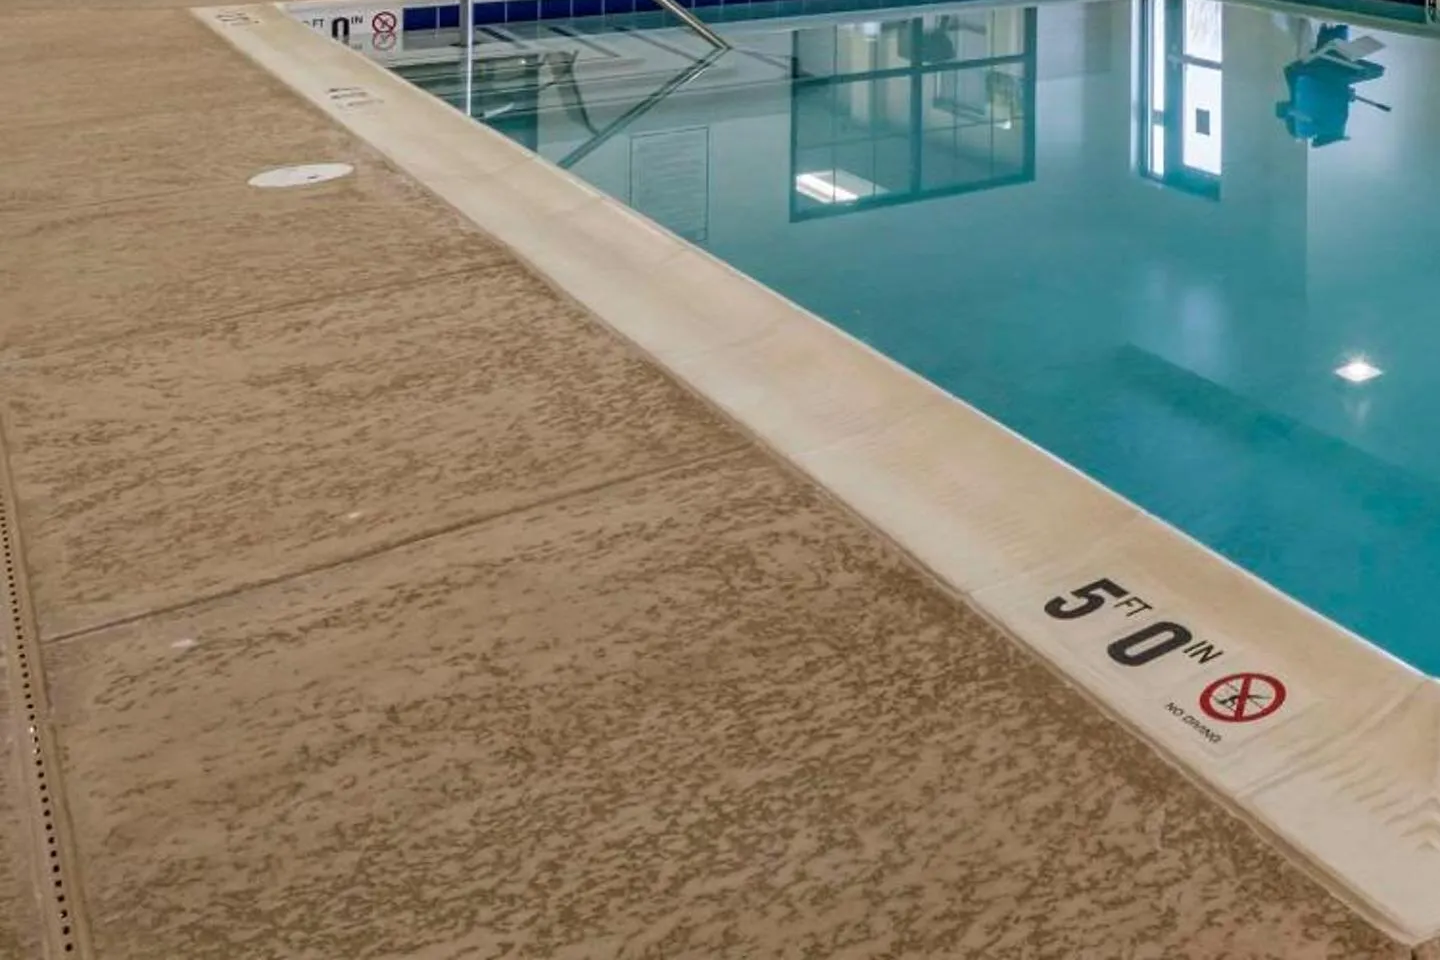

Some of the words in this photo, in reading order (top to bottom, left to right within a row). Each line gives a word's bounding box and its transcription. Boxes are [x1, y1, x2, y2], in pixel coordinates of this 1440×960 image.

[1044, 578, 1129, 620] 5
[1113, 596, 1153, 617] FT
[1107, 621, 1193, 666] 0
[1184, 640, 1224, 664] IN
[1165, 702, 1184, 717] NO
[1182, 715, 1222, 743] DIVING
